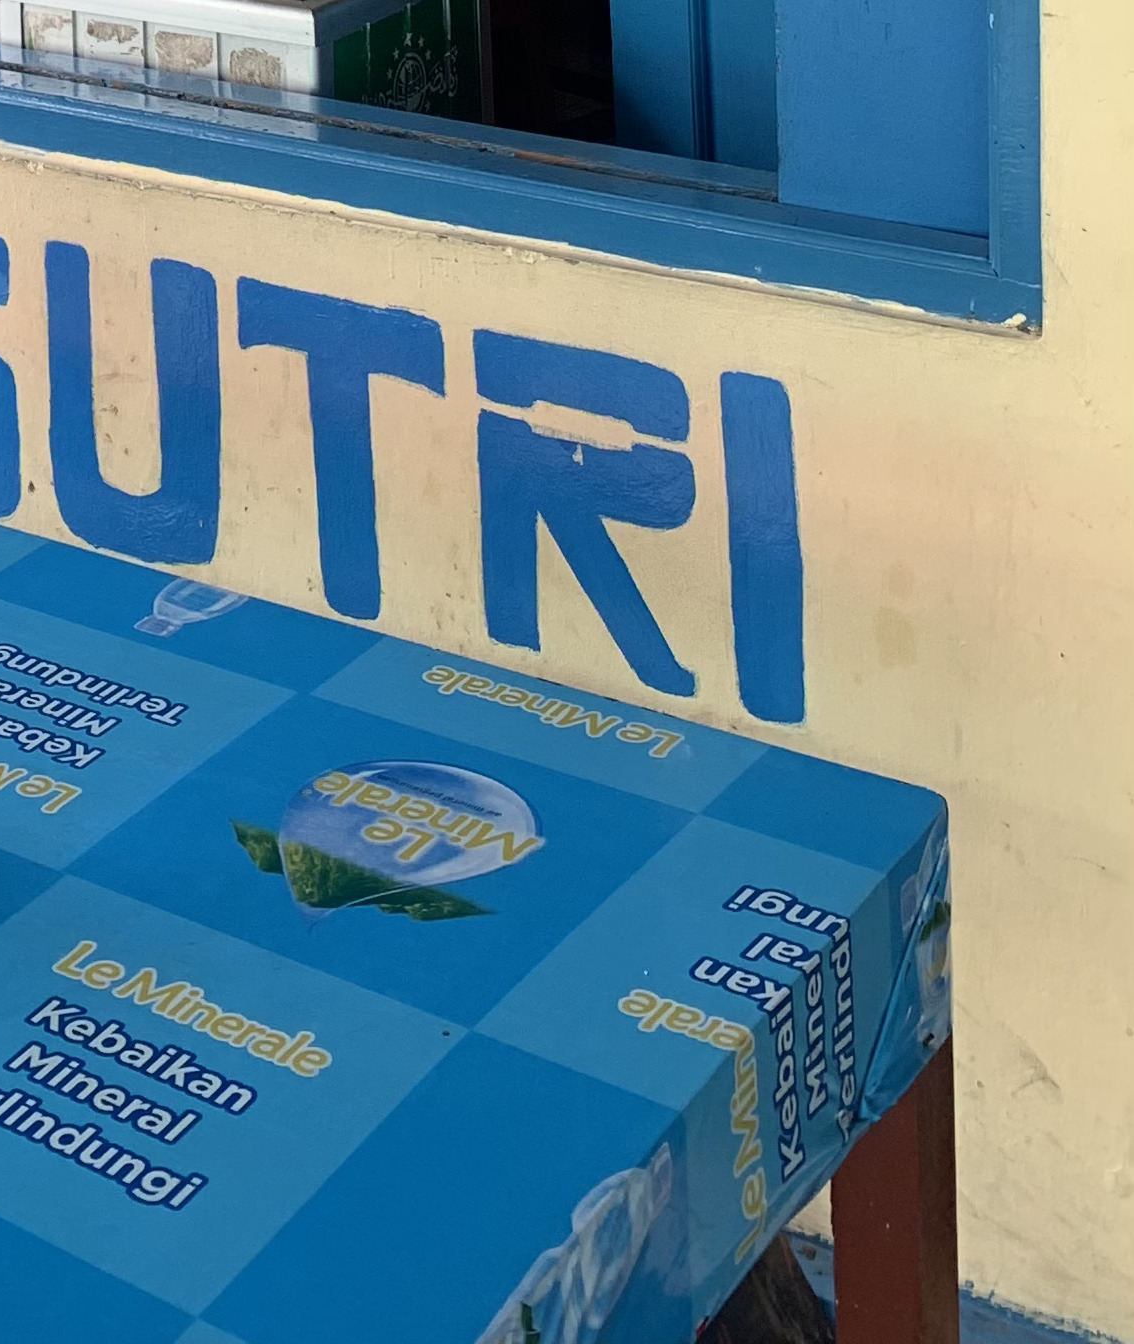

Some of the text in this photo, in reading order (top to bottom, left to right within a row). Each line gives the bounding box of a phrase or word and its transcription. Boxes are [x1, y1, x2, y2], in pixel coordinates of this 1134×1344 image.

[421, 664, 685, 759] Le Minerale
[15, 774, 82, 813] Le
[314, 771, 548, 863] Minerale
[363, 818, 436, 863] Le
[24, 996, 258, 1116] Kebaikan
[52, 940, 334, 1078] Le Minerale
[4, 1041, 203, 1146] Mineral
